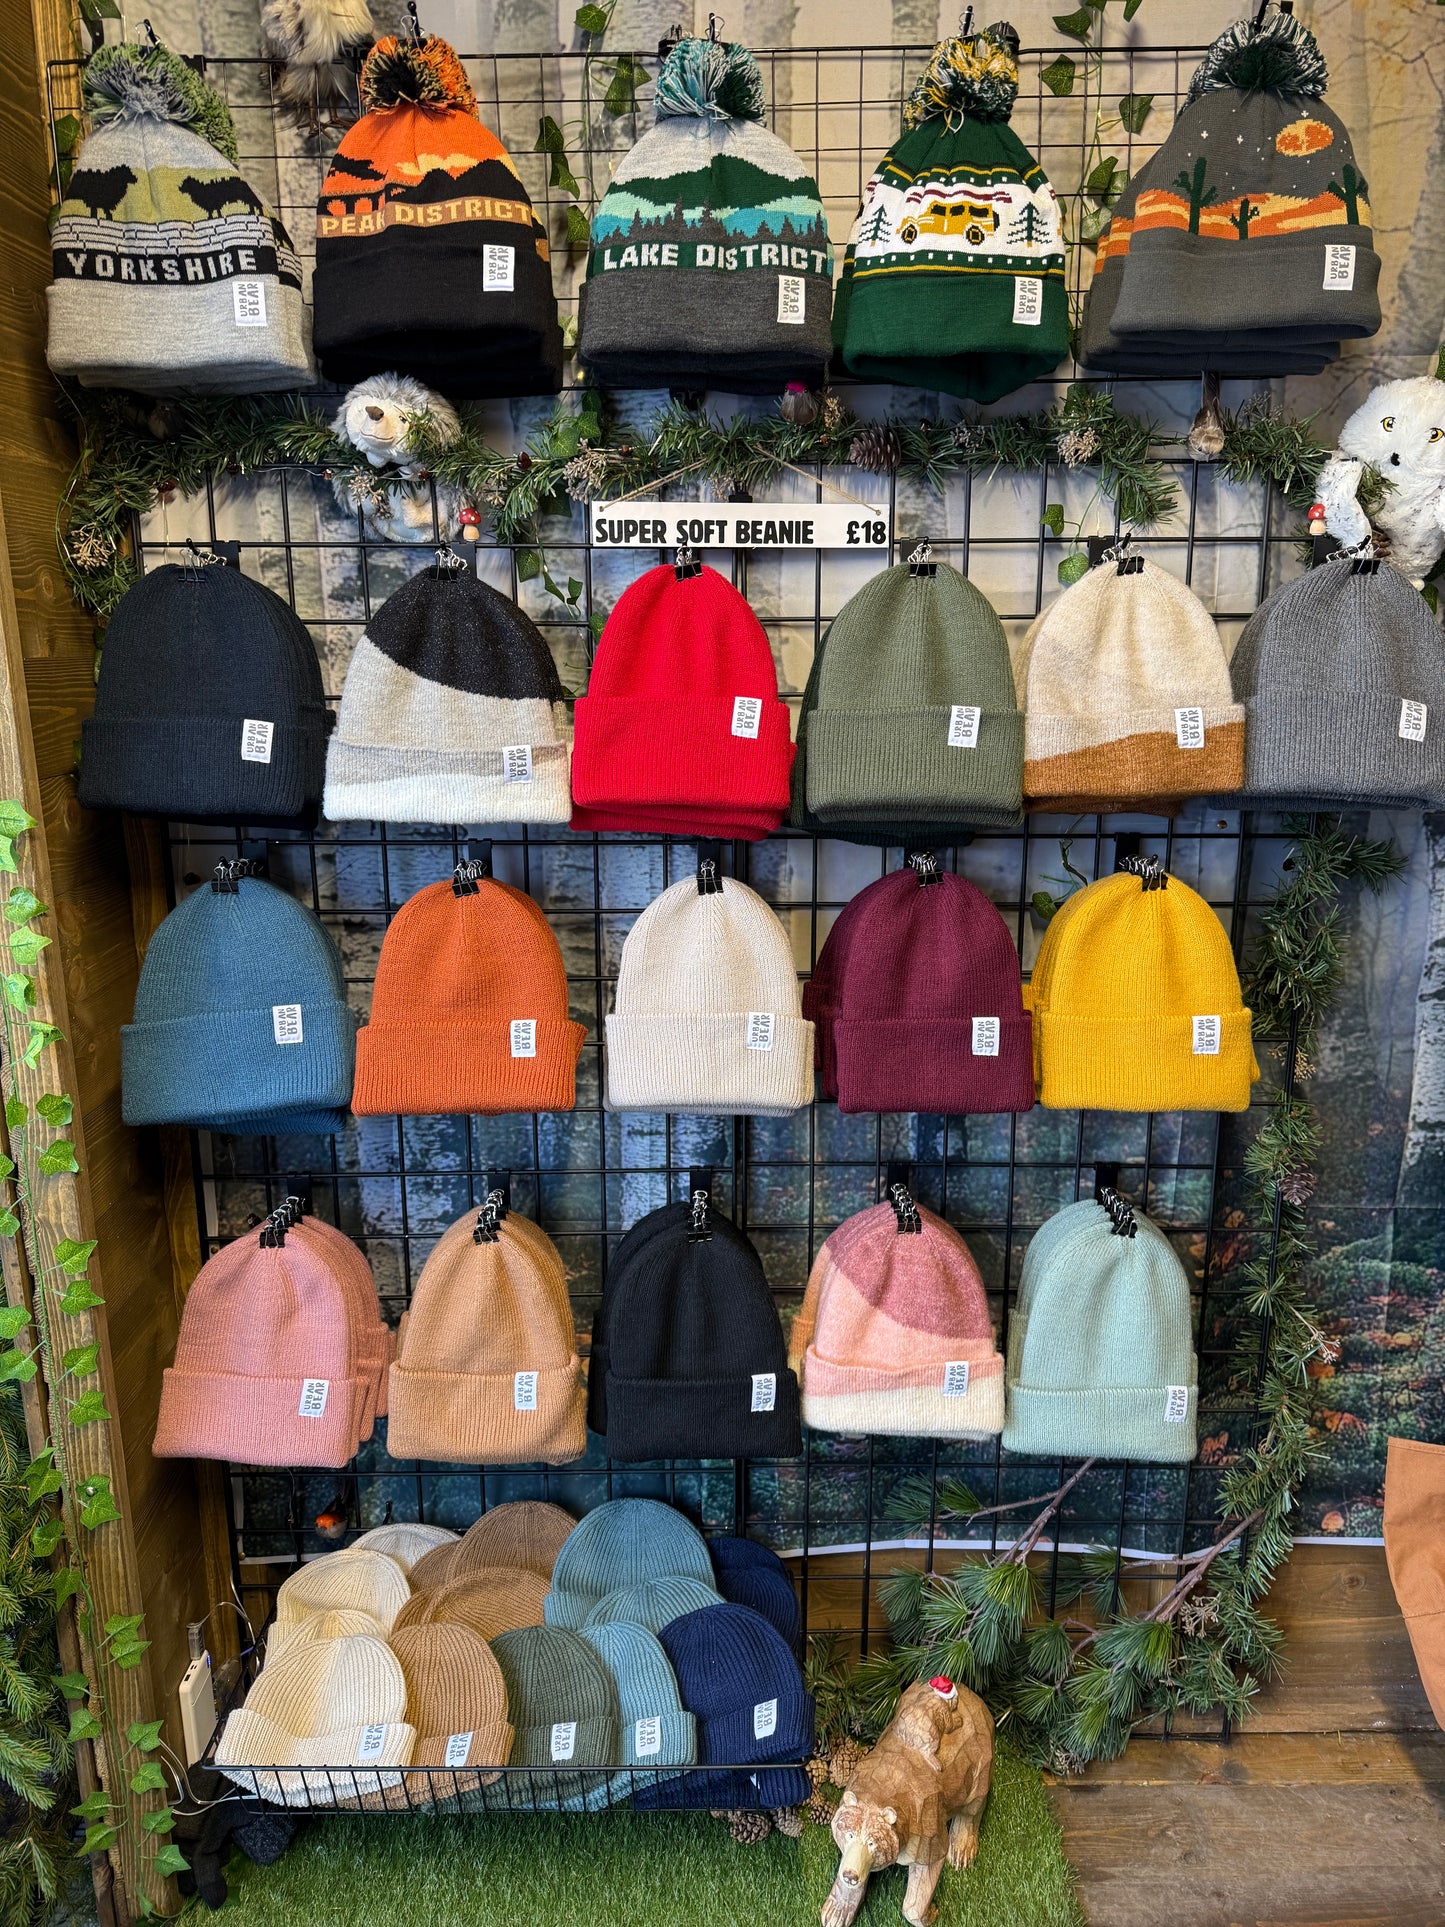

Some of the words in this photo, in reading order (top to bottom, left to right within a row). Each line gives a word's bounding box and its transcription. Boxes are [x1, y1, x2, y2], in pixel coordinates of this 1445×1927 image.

[321, 211, 386, 236] PEAK
[394, 198, 531, 224] DISTRICT
[66, 249, 257, 282] YORKSHIRE
[488, 247, 497, 281] URBAN
[497, 247, 509, 281] BEAR
[604, 243, 679, 271] LAKE
[696, 243, 827, 273] DISTRICT
[1330, 246, 1339, 279] URBAN
[1338, 246, 1350, 279] BEAR
[238, 284, 247, 316] URBAN
[247, 283, 259, 316] BEAR
[782, 279, 790, 313] URBAN
[790, 279, 800, 313] BEAR
[1019, 280, 1027, 314] URBAN
[1026, 280, 1037, 314] BEAR
[595, 518, 667, 544] SUPER
[676, 519, 727, 544] SOFT
[735, 520, 814, 545] BEANIE
[846, 520, 887, 545] £18
[736, 700, 745, 728] URBAN
[744, 700, 757, 729] BEAR
[954, 708, 963, 738] URBAN
[962, 708, 975, 738] BEAR
[1180, 711, 1188, 740] URBAN
[1188, 710, 1199, 740] BEAR
[1404, 702, 1413, 730] URBAN
[1412, 703, 1423, 731] BEAR
[247, 723, 256, 753] URBAN
[255, 723, 268, 754] BEAR
[508, 750, 516, 778] URBAN
[516, 747, 527, 777] BEAR
[286, 1006, 298, 1035] BEAR
[751, 1014, 760, 1042] URBAN
[759, 1014, 770, 1042] BEAR
[977, 1021, 985, 1048] URBAN
[984, 1020, 995, 1048] BEAR
[1205, 1018, 1215, 1047] BEAR
[514, 1021, 522, 1050] URBAN
[522, 1022, 531, 1050] BEAR
[524, 1374, 534, 1402] BEAR
[763, 1377, 773, 1404] BEAR
[955, 1364, 965, 1391] BEAR
[304, 1382, 314, 1410] URBAN
[312, 1382, 325, 1410] BEAR
[1170, 1390, 1178, 1416] URBAN
[1176, 1389, 1186, 1416] BEAR
